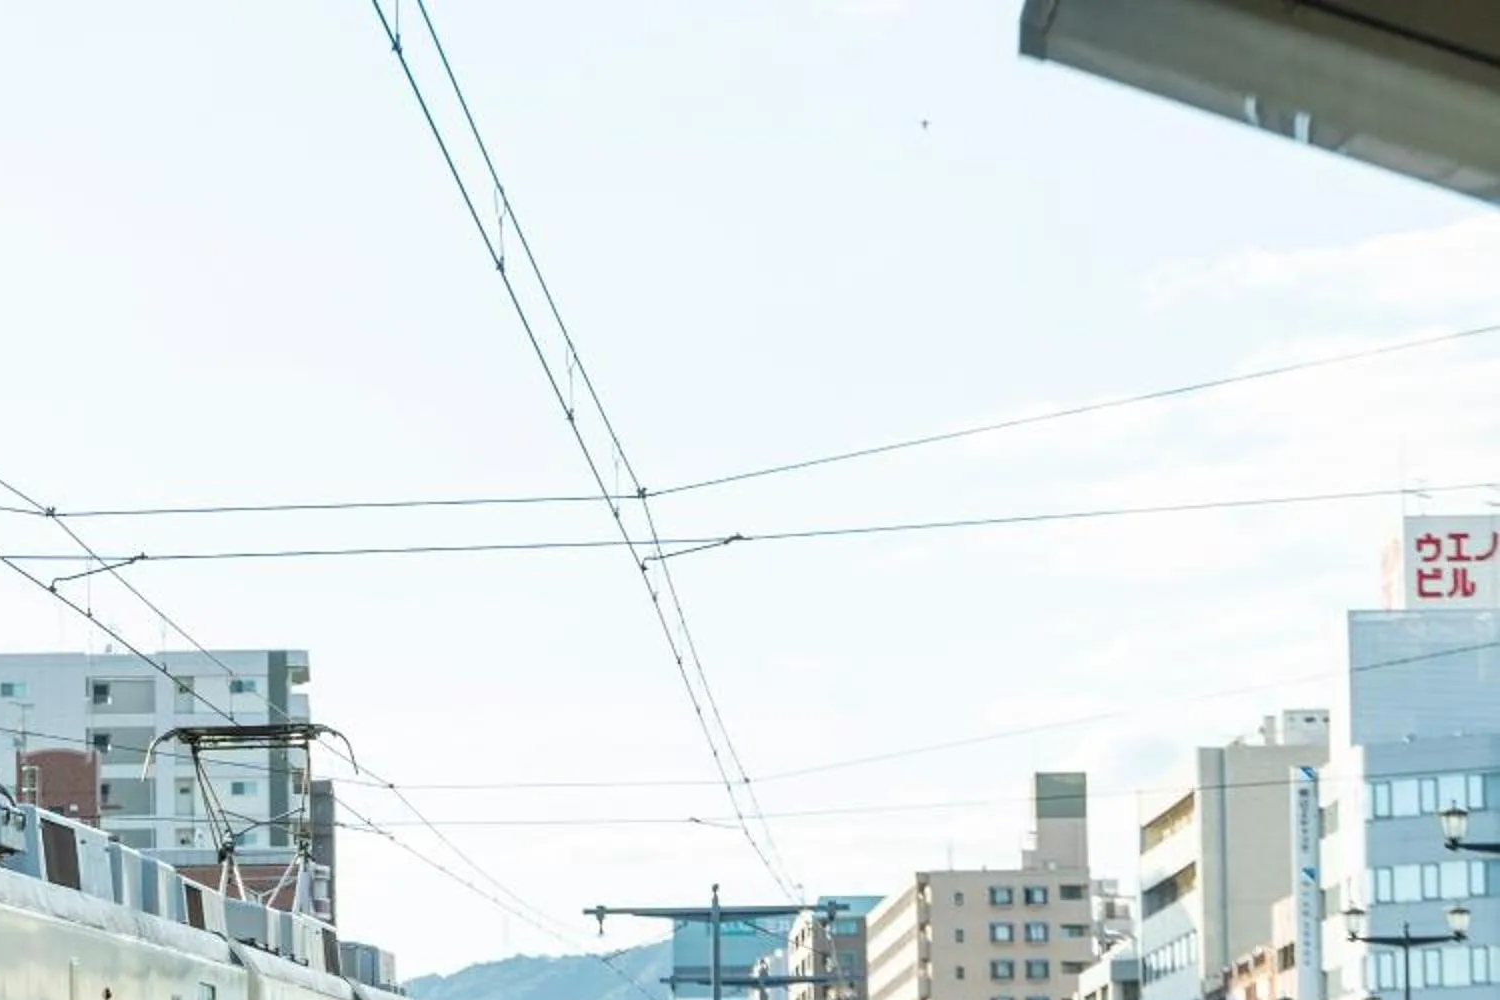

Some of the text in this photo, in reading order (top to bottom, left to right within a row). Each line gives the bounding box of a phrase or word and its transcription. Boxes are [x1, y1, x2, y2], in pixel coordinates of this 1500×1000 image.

[1415, 531, 1498, 563] ウエノ
[1417, 567, 1476, 598] ビル
